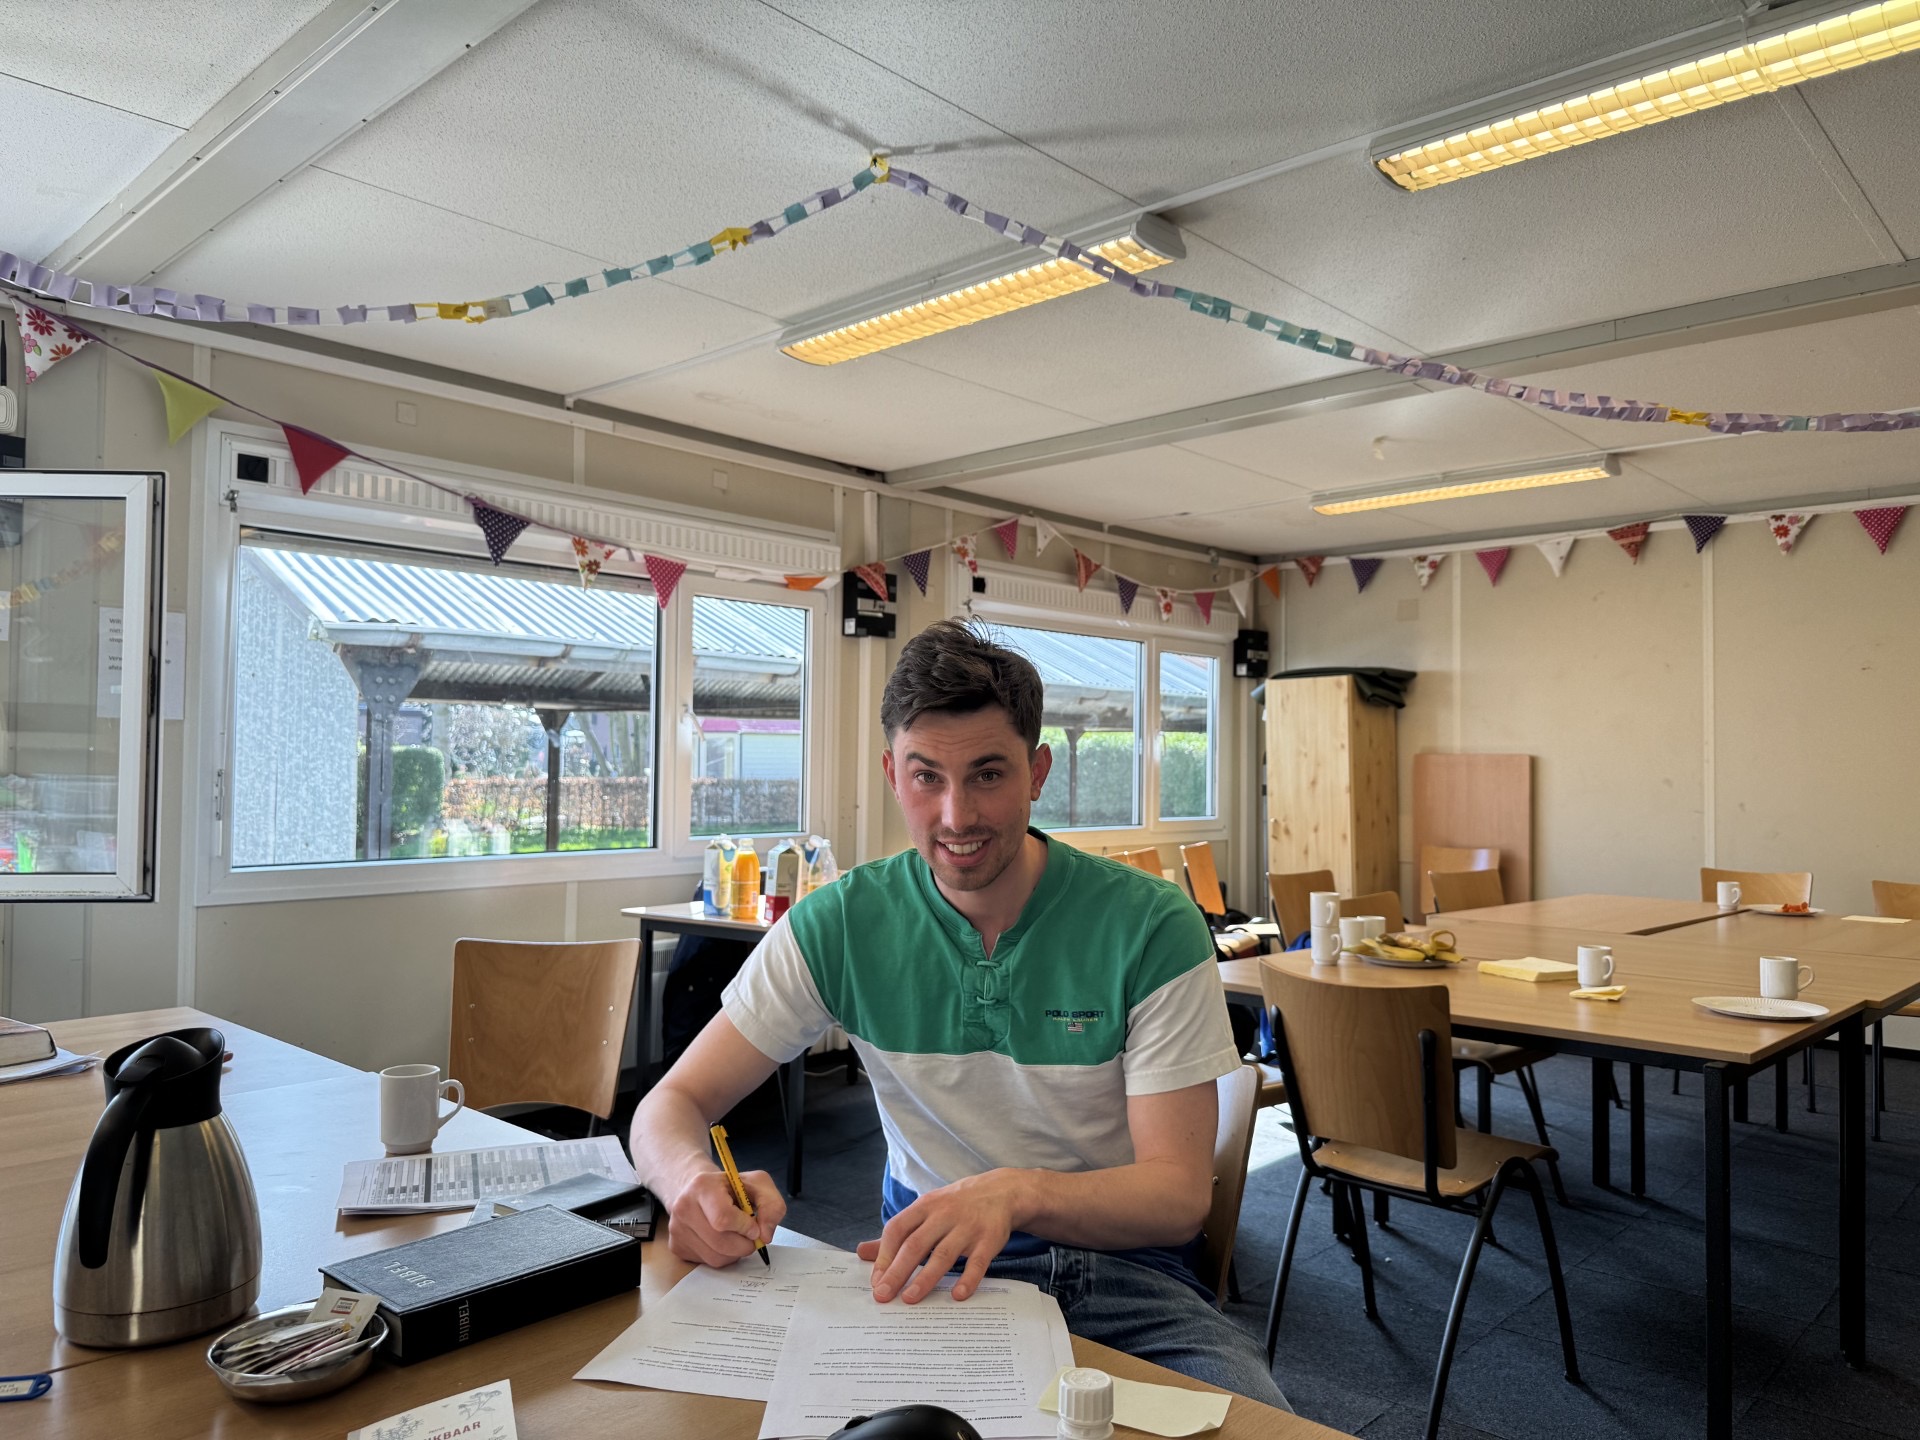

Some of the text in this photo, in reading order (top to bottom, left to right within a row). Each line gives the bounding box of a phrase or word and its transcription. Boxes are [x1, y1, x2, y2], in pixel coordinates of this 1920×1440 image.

[1045, 1009, 1105, 1018] POLO SPORT
[383, 1261, 436, 1288] BIJBEL
[458, 1299, 470, 1343] BIJBEL
[424, 1421, 481, 1440] KBAAR
